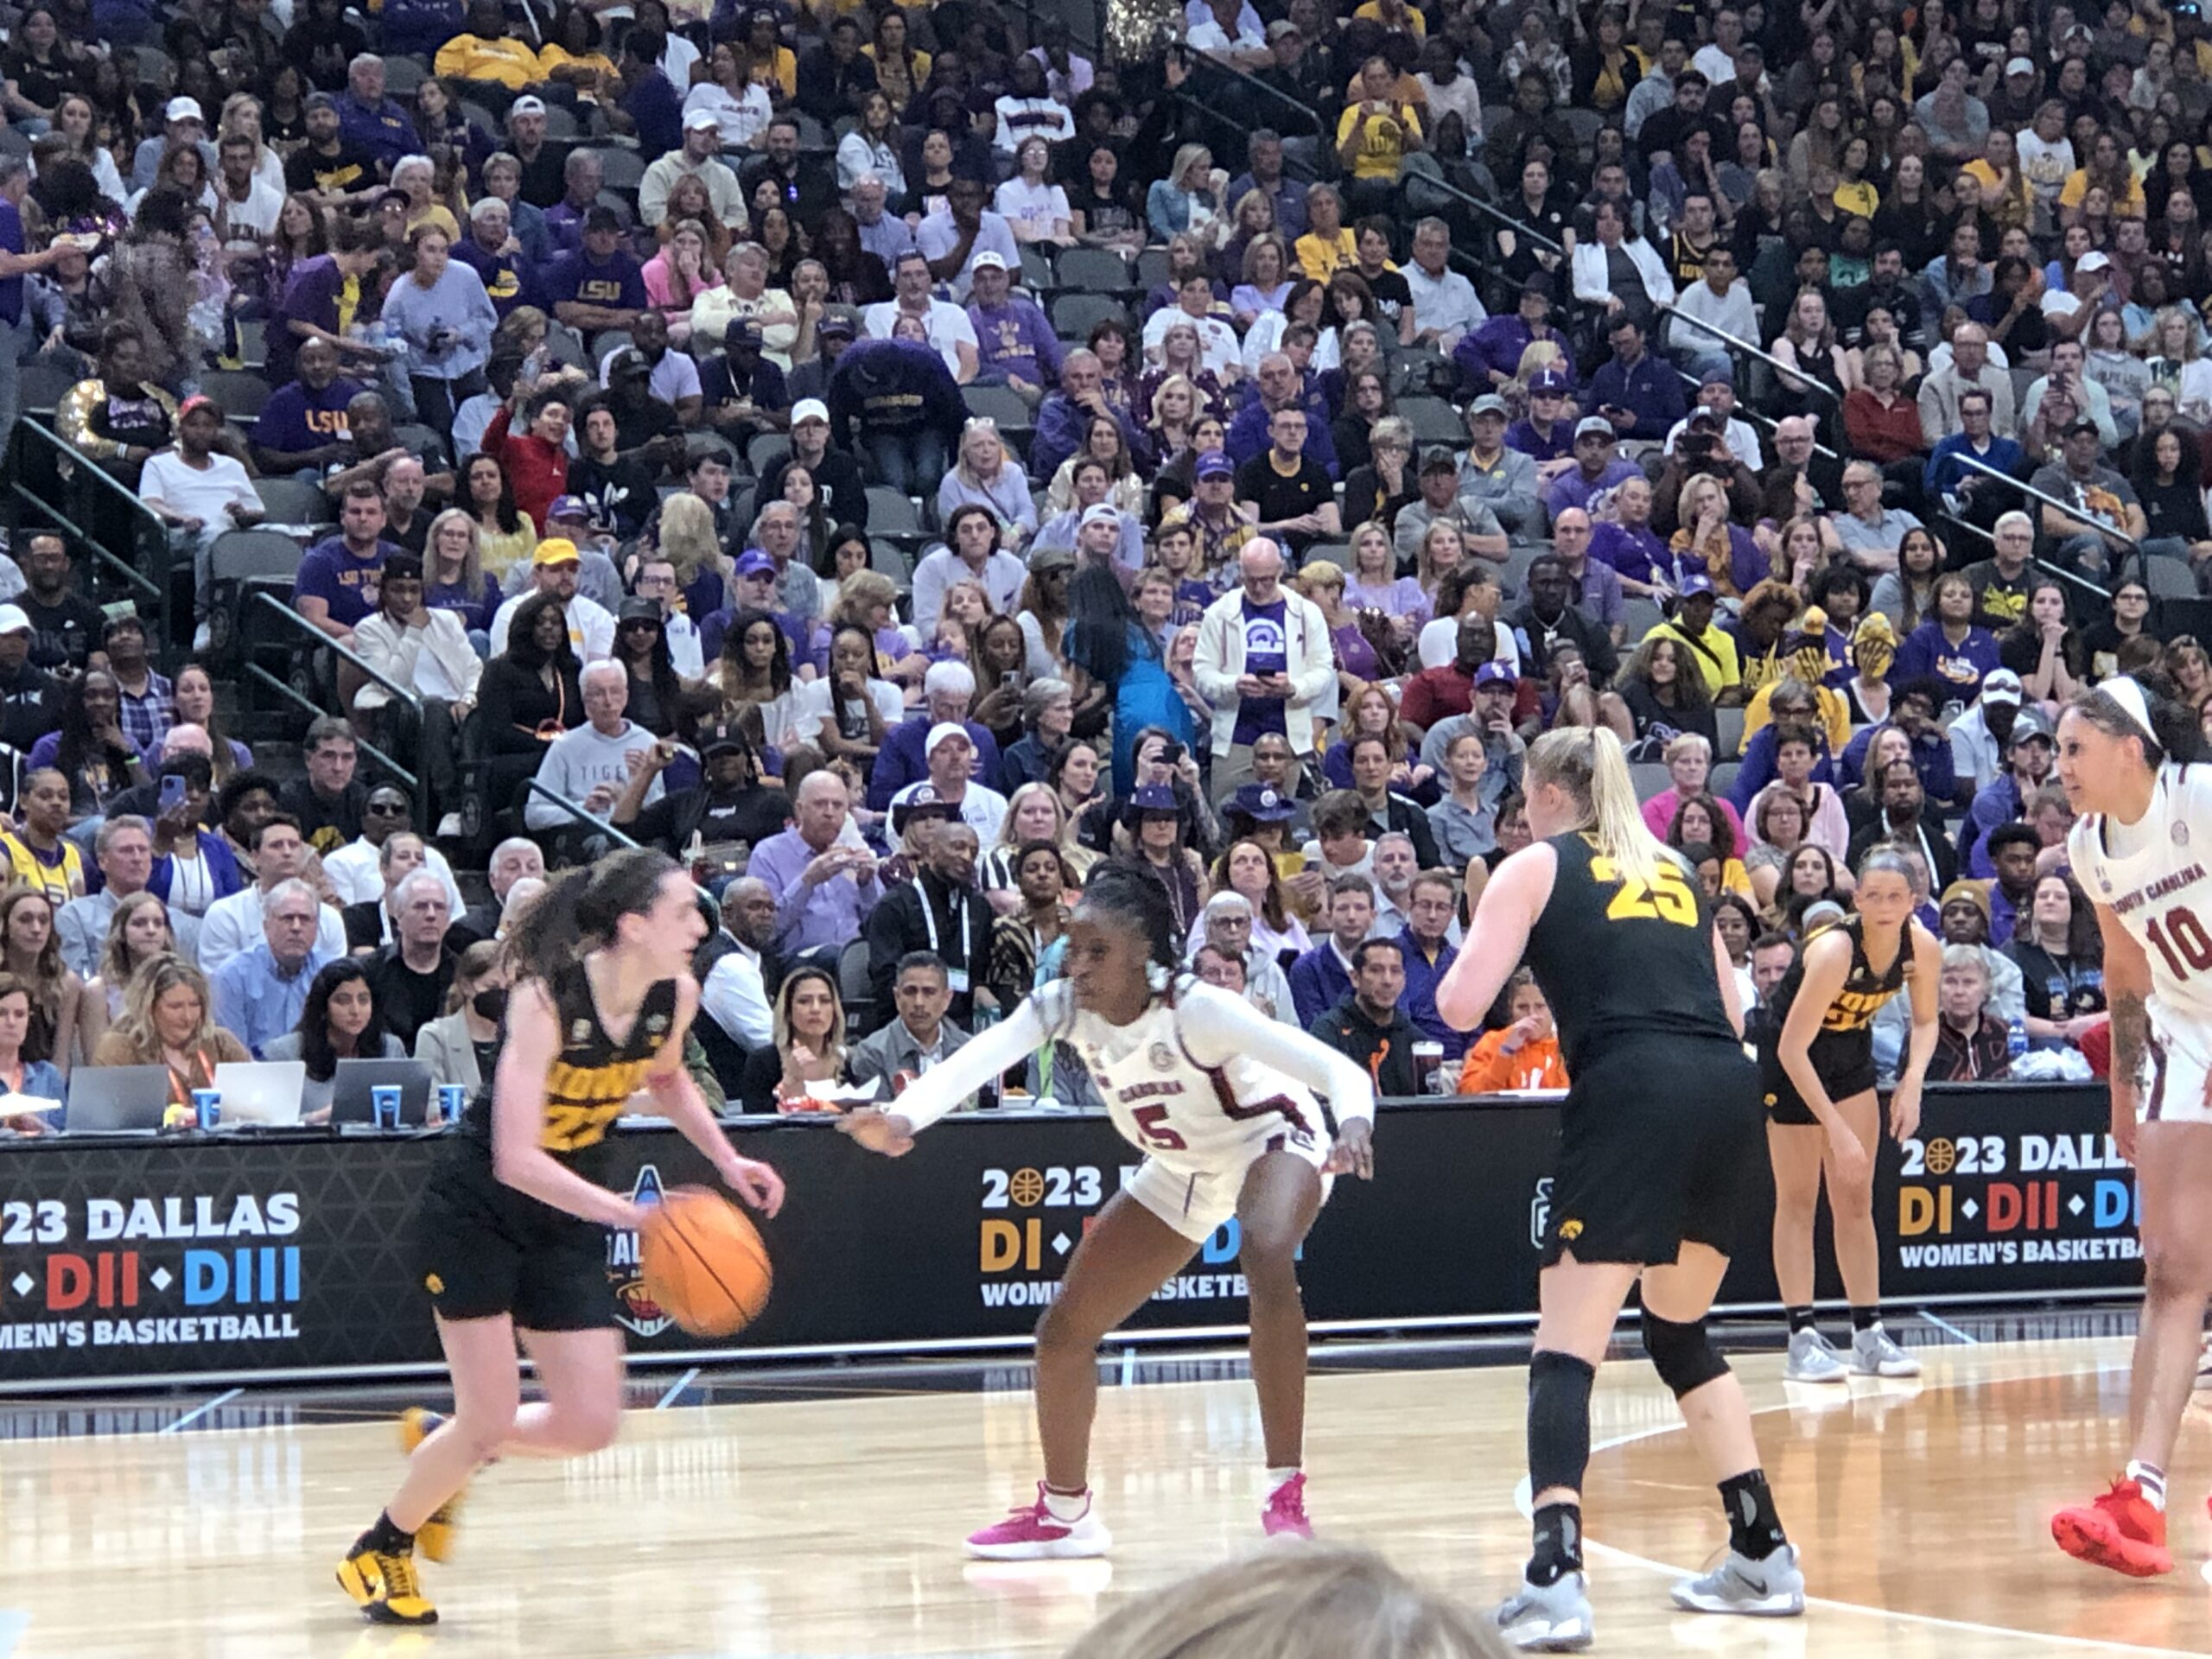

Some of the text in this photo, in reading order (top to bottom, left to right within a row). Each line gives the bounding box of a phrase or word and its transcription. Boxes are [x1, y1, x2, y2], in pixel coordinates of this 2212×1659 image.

[576, 279, 621, 302] LSU
[1543, 369, 1555, 385] L
[305, 409, 348, 434] LSU
[337, 570, 359, 586] LSU
[581, 765, 625, 781] TIGE
[1590, 855, 1699, 928] 25
[2145, 862, 2208, 900] CAROLINA
[2146, 905, 2212, 982] 10
[1900, 1133, 2127, 1176] 2023 DALL
[982, 1166, 1103, 1208] 2023
[86, 1192, 300, 1241] DALLAS
[1899, 1185, 1954, 1236] DI
[1987, 1180, 2059, 1232] DII
[980, 1217, 1042, 1273] DI
[1900, 1241, 2018, 1268] WOMEN'S
[47, 1246, 300, 1311] DII DIII
[982, 1281, 1066, 1307] WOM
[92, 1313, 300, 1345] BASKETBALL
